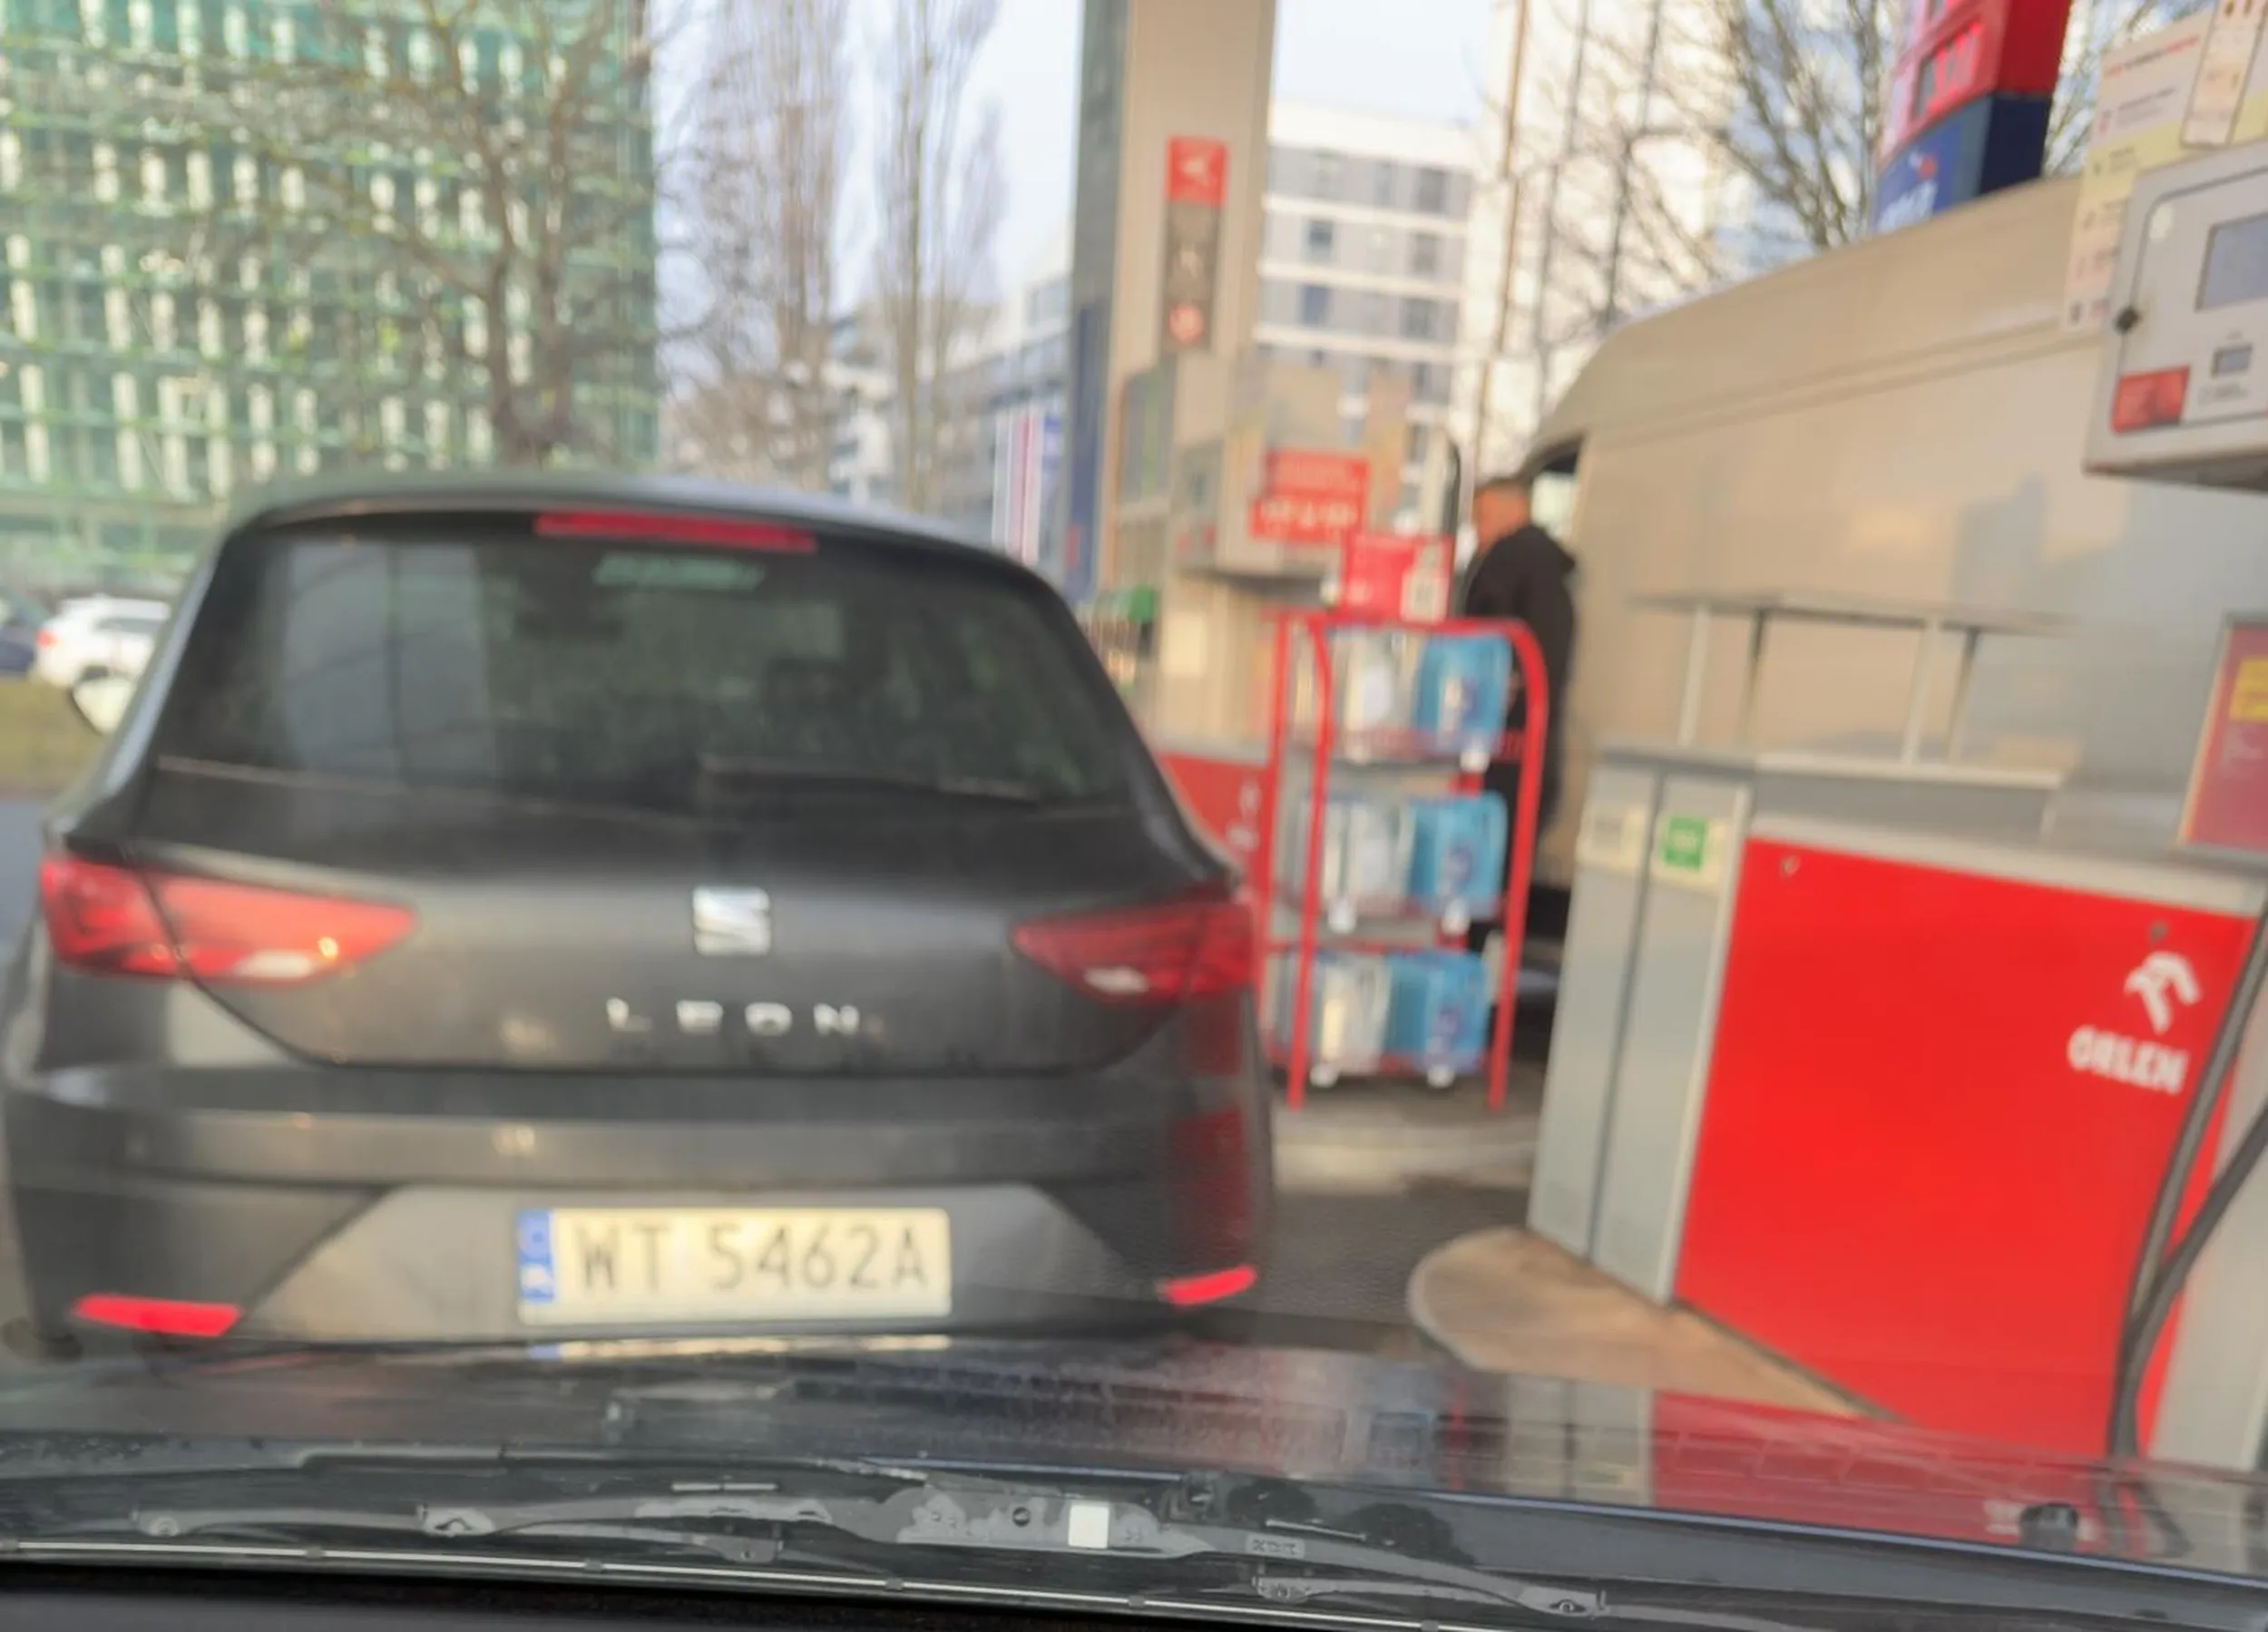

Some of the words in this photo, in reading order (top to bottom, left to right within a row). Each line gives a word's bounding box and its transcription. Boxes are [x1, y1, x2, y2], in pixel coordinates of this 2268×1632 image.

[605, 997, 861, 1036] LEON
[2068, 1026, 2188, 1093] ORLEN
[575, 1223, 671, 1293] WT
[708, 1221, 930, 1293] 5462A
